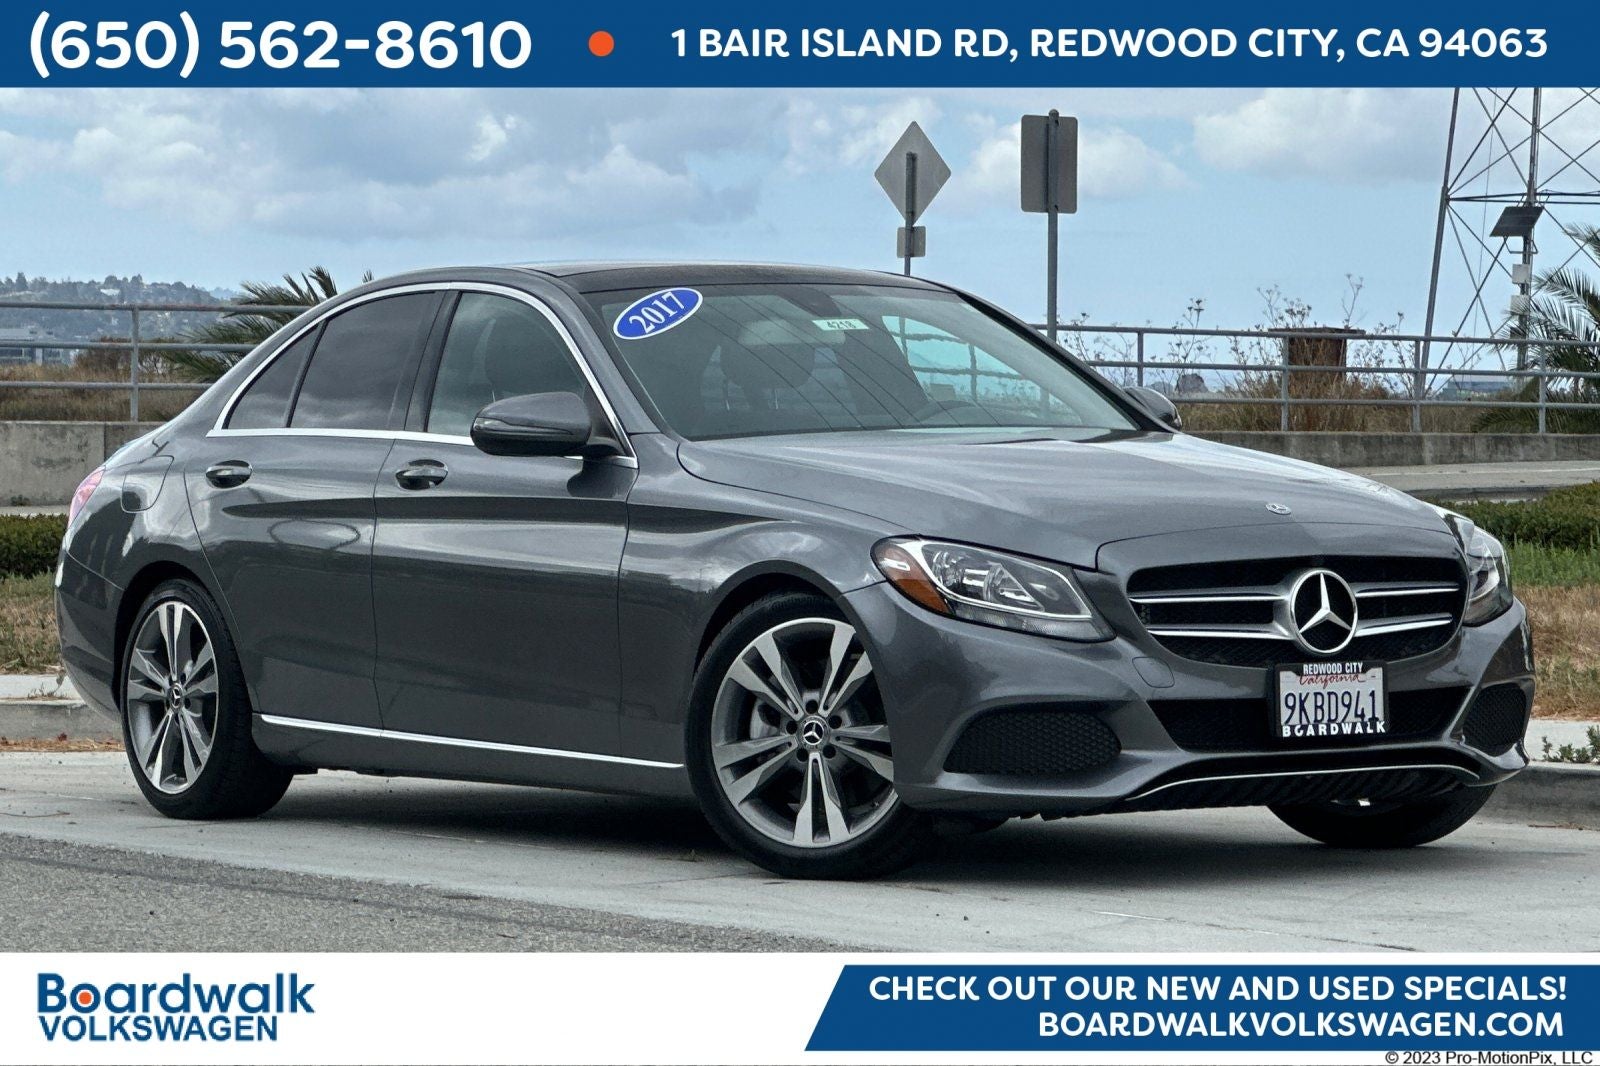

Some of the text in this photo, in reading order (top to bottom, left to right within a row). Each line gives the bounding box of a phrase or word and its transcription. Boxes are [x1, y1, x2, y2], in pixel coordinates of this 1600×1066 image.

[629, 291, 684, 333] 2017
[1303, 662, 1363, 674] REDWOOD CITY
[1299, 673, 1365, 689] California
[1284, 690, 1379, 723] 9KBD941
[1282, 721, 1386, 737] BOARDWALK
